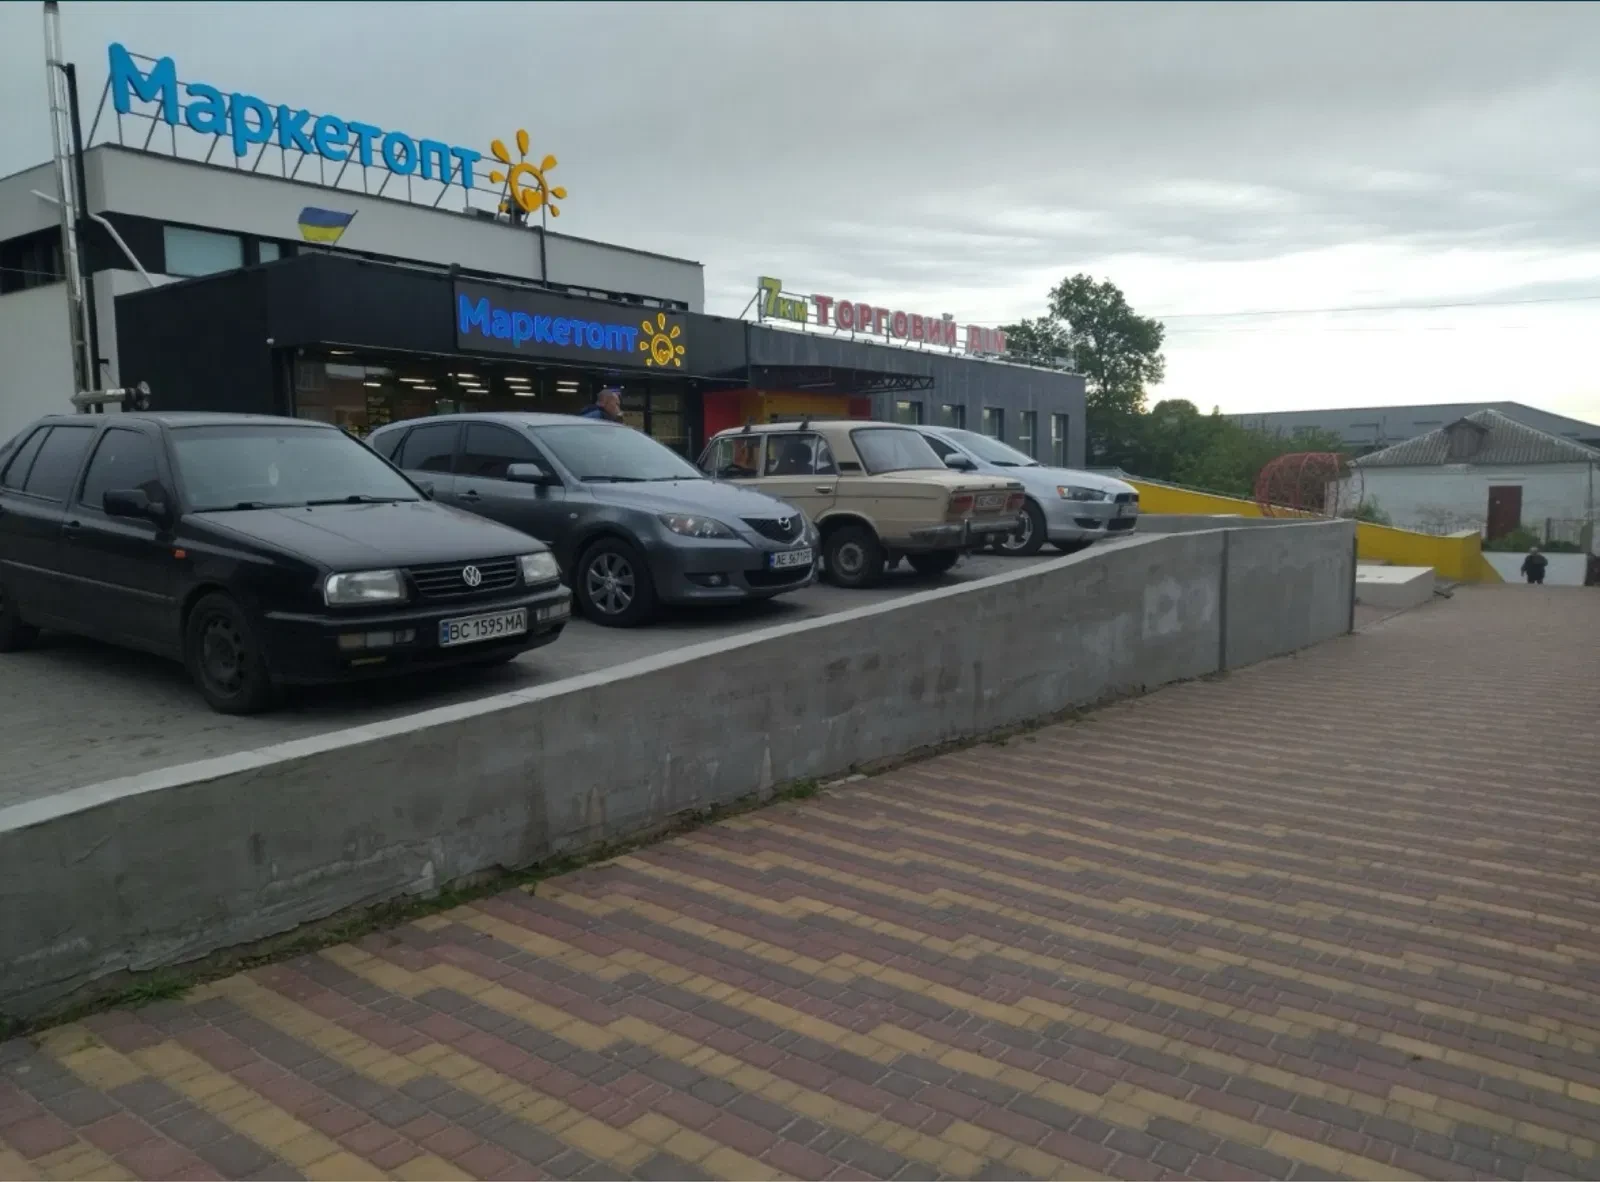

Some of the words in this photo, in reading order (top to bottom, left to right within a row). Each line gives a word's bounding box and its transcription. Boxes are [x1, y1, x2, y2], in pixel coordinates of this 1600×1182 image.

[109, 42, 482, 189] Маркетопт
[458, 293, 638, 353] Маркетопт
[811, 294, 957, 348] ТОРГОВИЙ
[965, 325, 1006, 354] ДІМ
[450, 622, 470, 640] BC
[473, 618, 503, 637] 1595
[505, 613, 523, 631] MA
